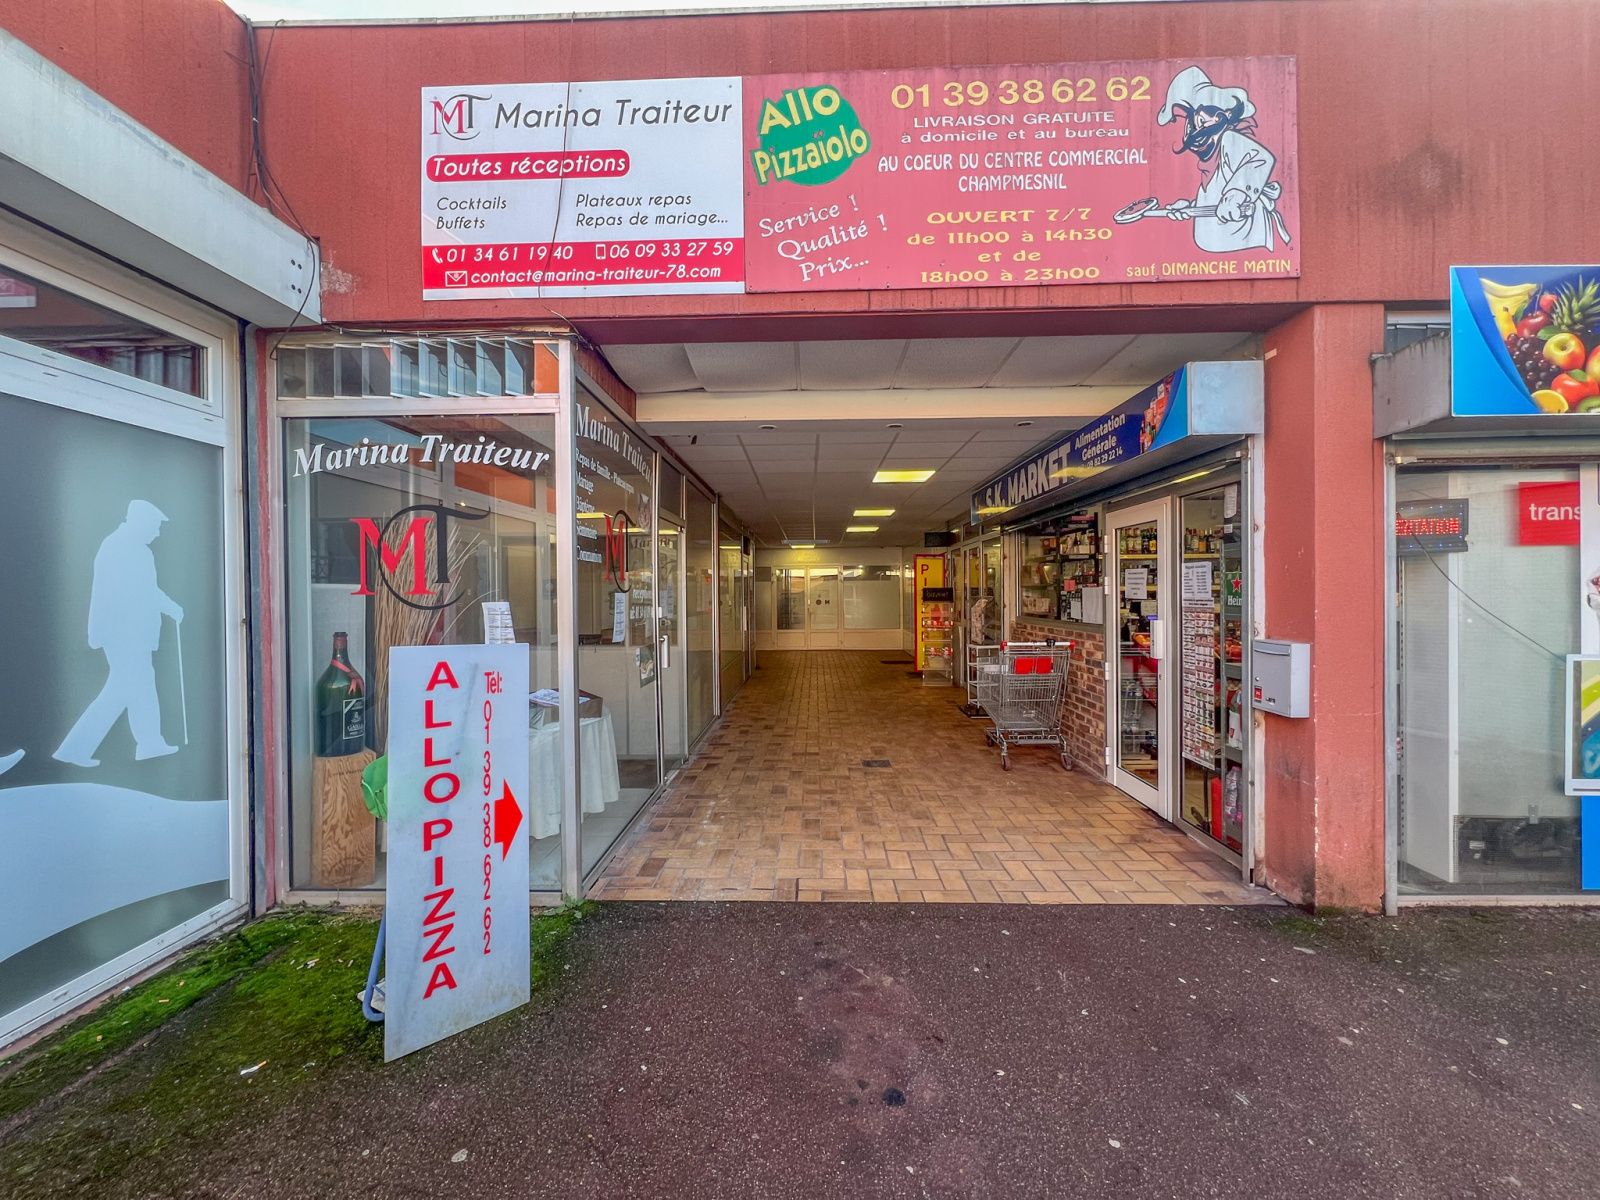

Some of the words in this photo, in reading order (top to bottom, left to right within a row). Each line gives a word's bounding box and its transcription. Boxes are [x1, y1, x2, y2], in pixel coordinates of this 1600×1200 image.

[891, 84, 929, 109] 01
[943, 81, 989, 106] 39
[998, 80, 1044, 104] 38
[1052, 78, 1097, 103] 62
[1106, 76, 1151, 101] 62
[495, 102, 601, 128] Marina
[616, 99, 732, 126] Traiteur
[760, 88, 840, 134] Allo
[914, 114, 1014, 128] LIVRAISON
[1023, 111, 1115, 125] GRATUITE
[901, 133, 911, 143] à
[920, 130, 998, 142] domicile
[1007, 129, 1026, 140] et
[1035, 129, 1056, 139] au
[1066, 128, 1129, 138] bureau
[434, 157, 502, 177] Toutes
[510, 154, 626, 175] réceptions
[878, 156, 898, 172] AU
[904, 154, 952, 171] COEUR
[959, 153, 979, 169] DU
[984, 151, 1043, 169] CENTRE
[1049, 148, 1148, 167] COMMERCIAL
[958, 174, 1067, 192] CHAMPMESNIL
[437, 196, 507, 211] Cocktails
[576, 193, 642, 208] Plateaux
[648, 193, 692, 206] repas
[436, 216, 485, 230] Buffets
[576, 214, 623, 228] Repas
[629, 212, 648, 225] de
[654, 212, 728, 226] mariage...
[759, 204, 840, 237] Service
[848, 194, 858, 211] !
[927, 210, 1035, 224] OUVERT
[1046, 208, 1091, 222] 7/7
[778, 220, 868, 260] Qualité
[877, 214, 887, 231] !
[907, 234, 935, 245] de
[948, 231, 1010, 244] 11h00
[1021, 231, 1034, 242] à
[1045, 228, 1112, 241] 14h30
[447, 247, 465, 262] 01
[473, 246, 493, 262] 34
[499, 246, 517, 261] 61
[528, 245, 547, 260] 19
[553, 245, 573, 260] 40
[610, 244, 630, 258] 06
[635, 243, 656, 257] 09
[661, 242, 681, 257] 33
[687, 241, 707, 256] 27
[713, 241, 733, 255] 59
[978, 251, 1001, 262] et
[1013, 250, 1041, 262] de
[471, 264, 721, 283] contact@marina-traiteur-78.com
[799, 257, 869, 282] Prix...
[921, 270, 988, 283] 18h00
[1000, 270, 1013, 281] à
[1024, 267, 1100, 281] 23h00
[1127, 264, 1155, 277] sauf
[1162, 261, 1237, 275] DIMANCHE
[1244, 260, 1291, 273] MATIN
[576, 403, 620, 453] Marina
[1075, 412, 1126, 451] Alimentation
[292, 437, 409, 477] Marina
[419, 435, 550, 471] Traiteur
[1082, 435, 1116, 461] Générale
[1094, 456, 1101, 466] 82
[1101, 453, 1108, 463] 29
[1108, 450, 1115, 460] 22
[1116, 446, 1123, 457] 14
[484, 671, 502, 694] Tél:
[424, 661, 460, 804] ALLO
[484, 700, 492, 744] 01
[483, 750, 491, 796] 39
[483, 802, 492, 848] 38
[483, 854, 492, 900] 62
[422, 818, 458, 1000] PIZZA
[483, 907, 492, 954] 62
